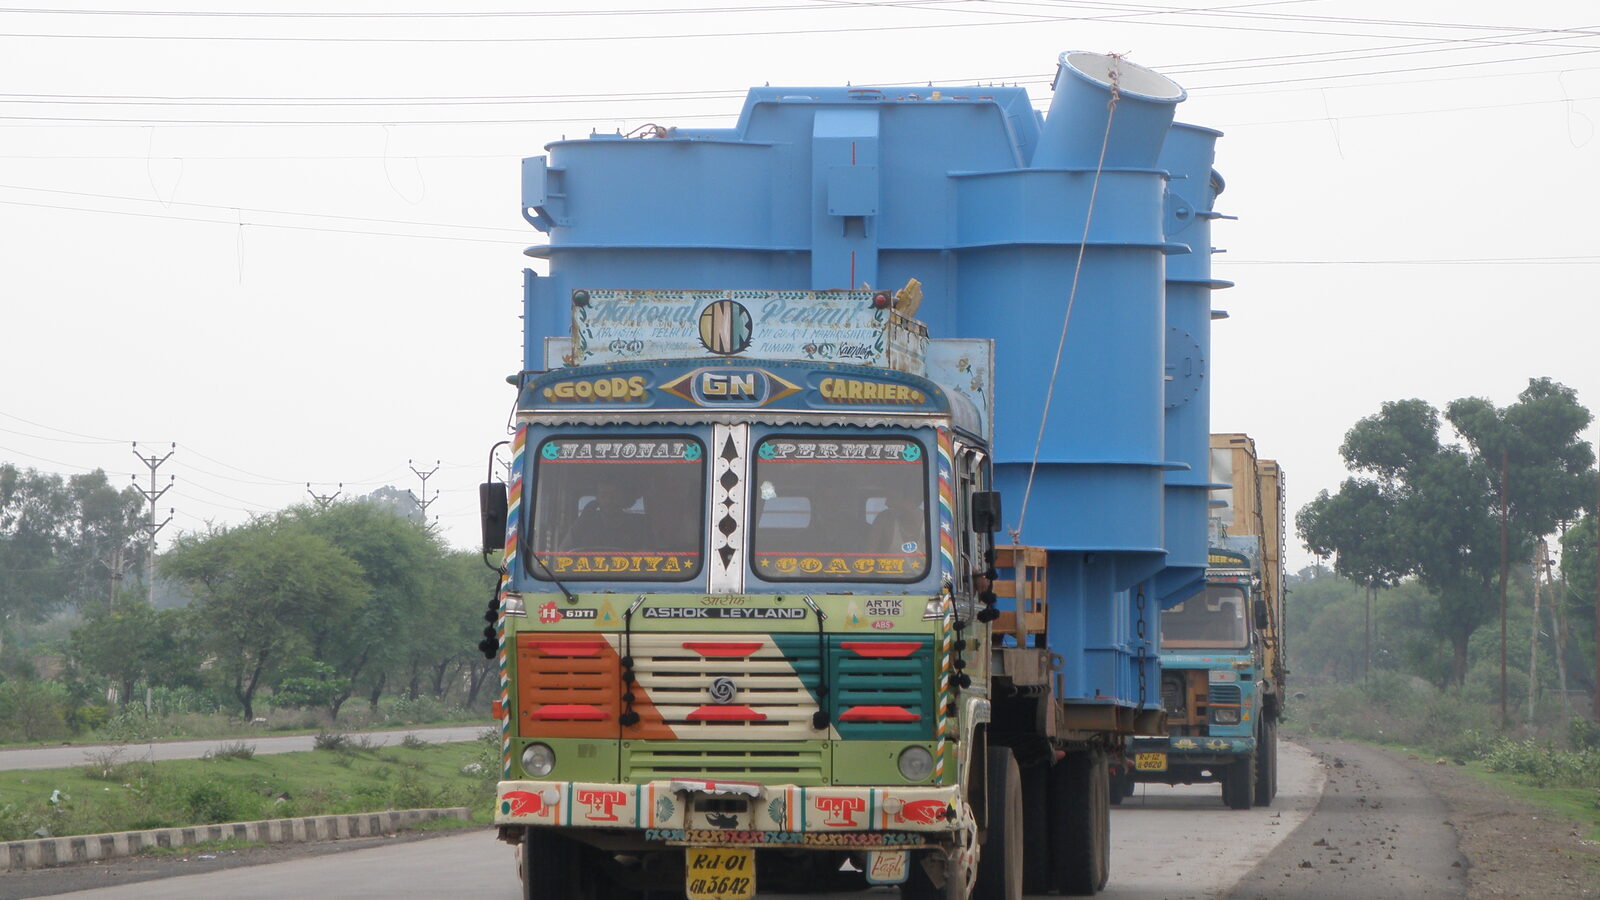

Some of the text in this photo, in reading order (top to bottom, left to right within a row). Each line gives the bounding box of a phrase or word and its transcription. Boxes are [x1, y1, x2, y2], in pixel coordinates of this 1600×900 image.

[554, 376, 645, 400] GOODS
[702, 372, 755, 399] GN
[819, 378, 910, 401] CARRIER
[557, 442, 686, 459] NATIONAL
[773, 442, 904, 459] PERMIT
[553, 556, 682, 573] PALDIYA
[774, 557, 904, 573] COACH
[866, 599, 903, 608] ARTIK
[869, 607, 900, 616] 3516
[645, 607, 805, 619] ASHOK LEYLAND
[875, 621, 891, 629] ABS
